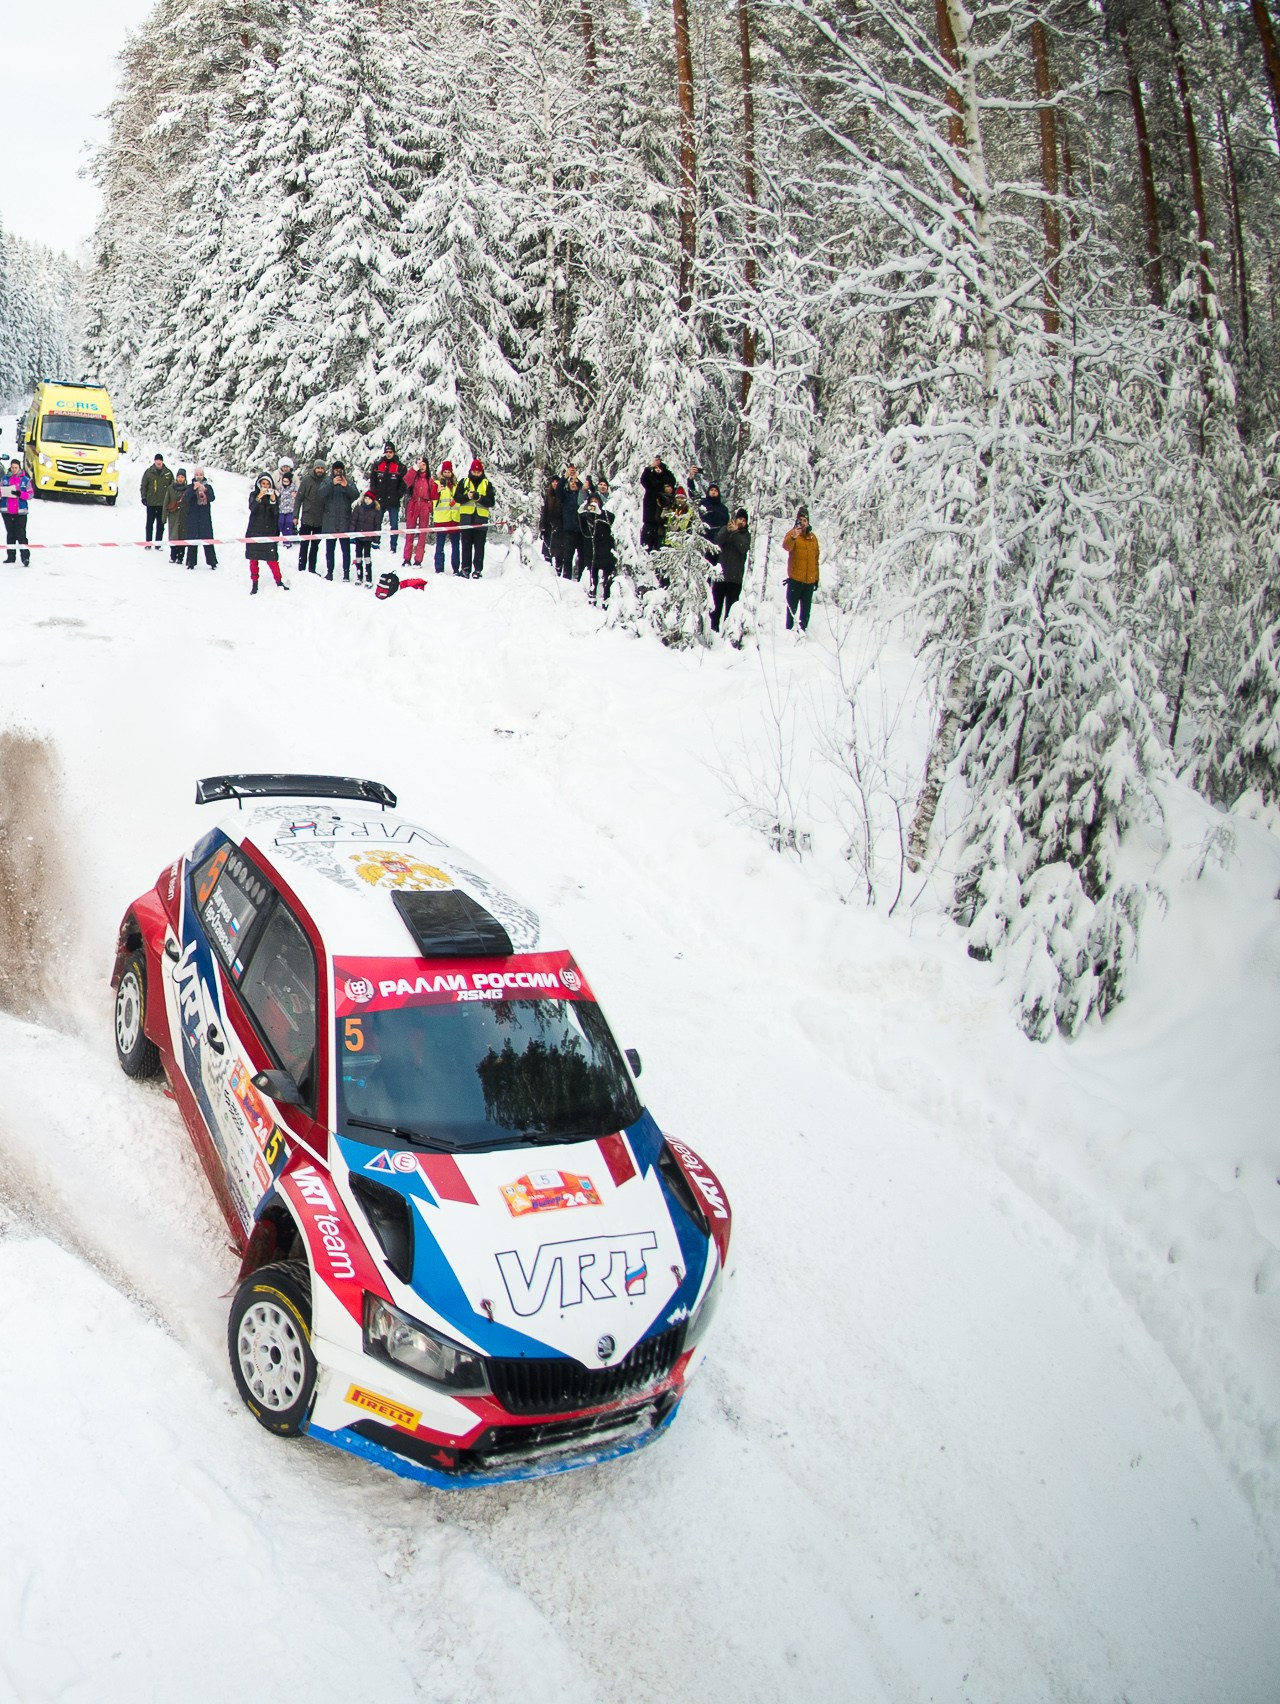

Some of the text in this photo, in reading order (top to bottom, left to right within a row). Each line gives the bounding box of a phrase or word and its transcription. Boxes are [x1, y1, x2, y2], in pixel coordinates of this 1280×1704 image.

[56, 400, 98, 410] CORIS
[198, 850, 228, 903] 5
[379, 972, 560, 997] РАЛЛИ РОССИИ
[344, 1018, 365, 1052] 5
[266, 1128, 283, 1165] 5
[562, 1191, 588, 1207] 24
[689, 1170, 728, 1219] VRT
[290, 1166, 355, 1278] VRT team
[495, 1231, 658, 1317] VRT
[352, 1390, 415, 1425] PIRELLI
